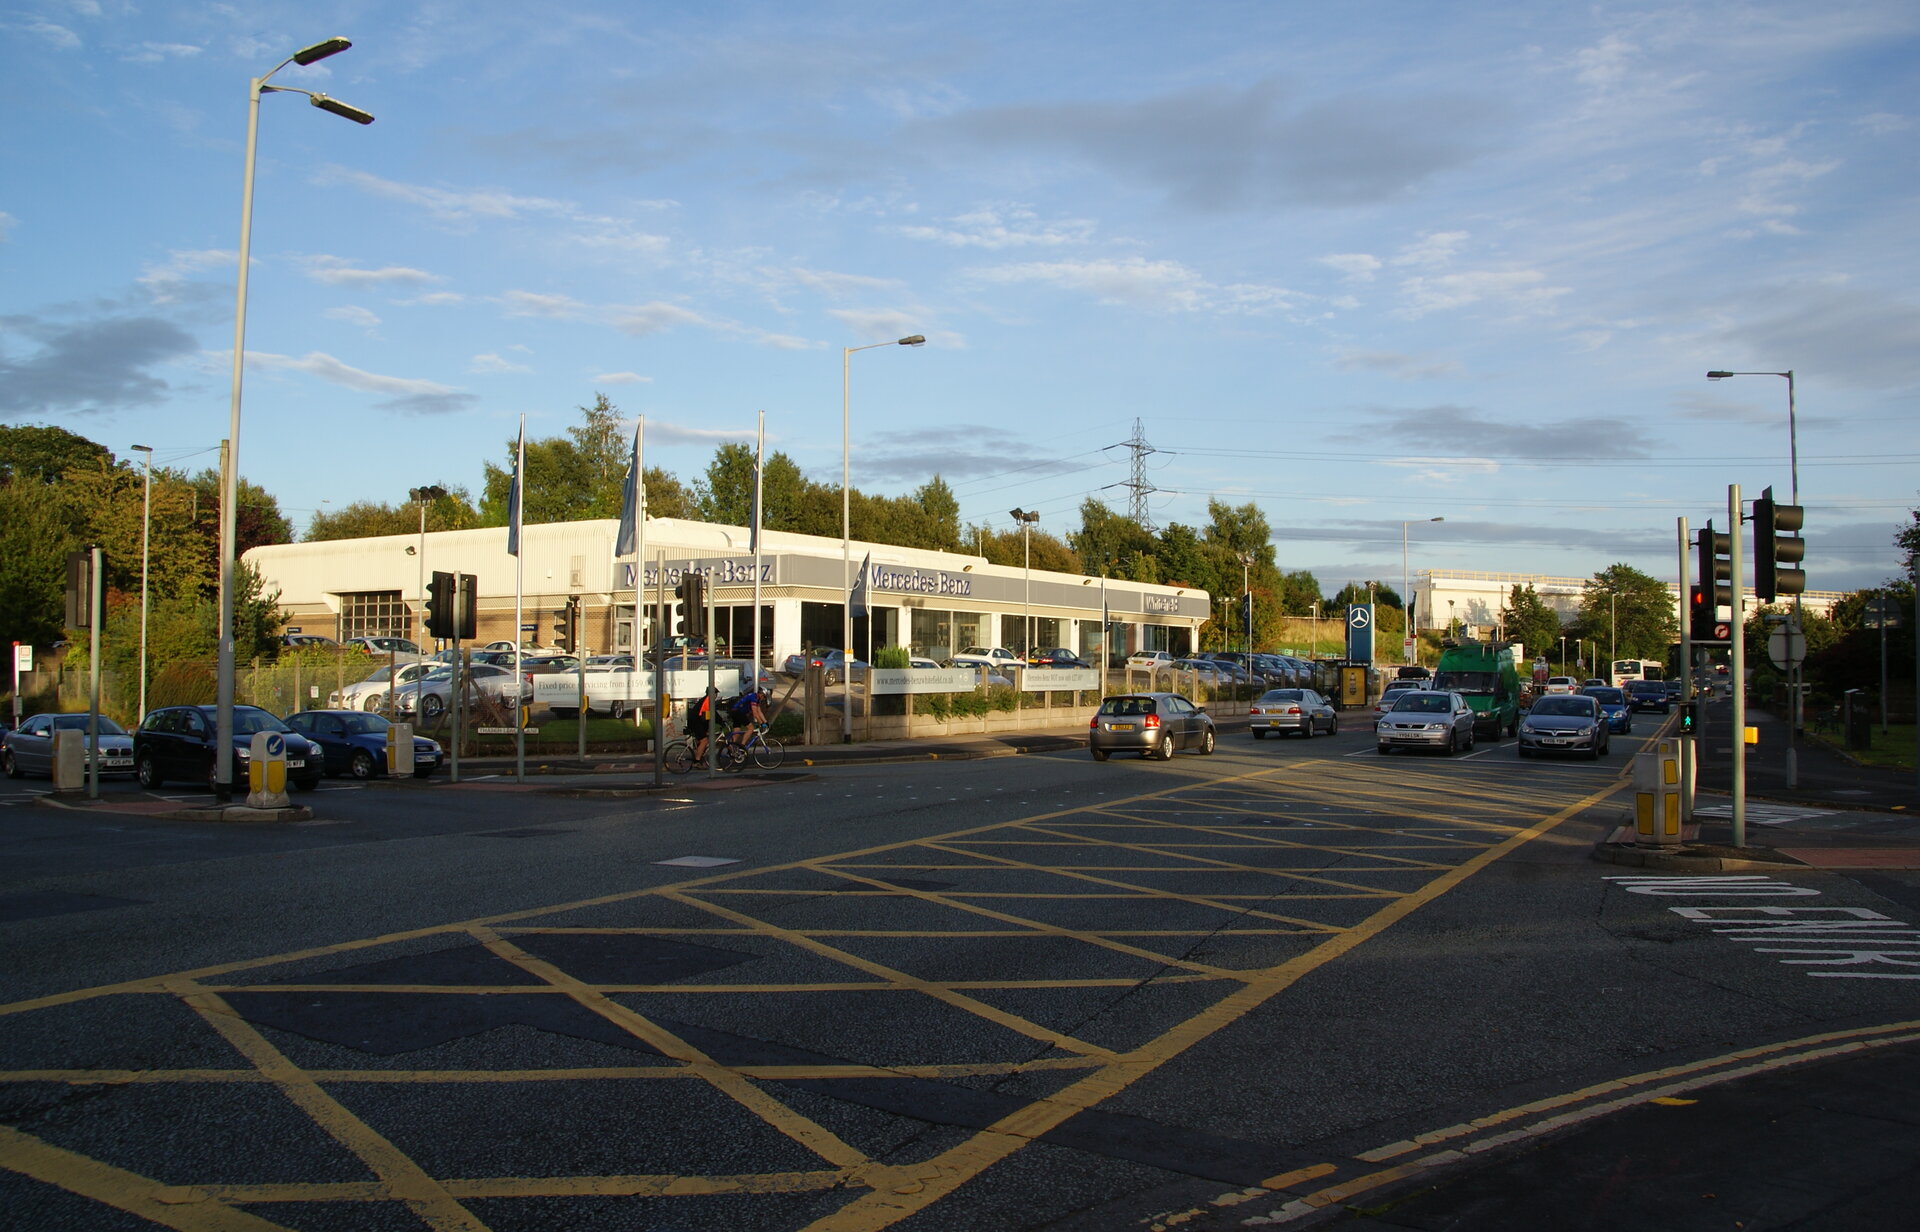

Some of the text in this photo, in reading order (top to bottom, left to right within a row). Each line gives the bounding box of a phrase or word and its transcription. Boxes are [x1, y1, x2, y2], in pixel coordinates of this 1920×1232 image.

[870, 565, 971, 596] Mercedes-Benz
[538, 681, 557, 690] Fixed
[559, 681, 576, 691] price
